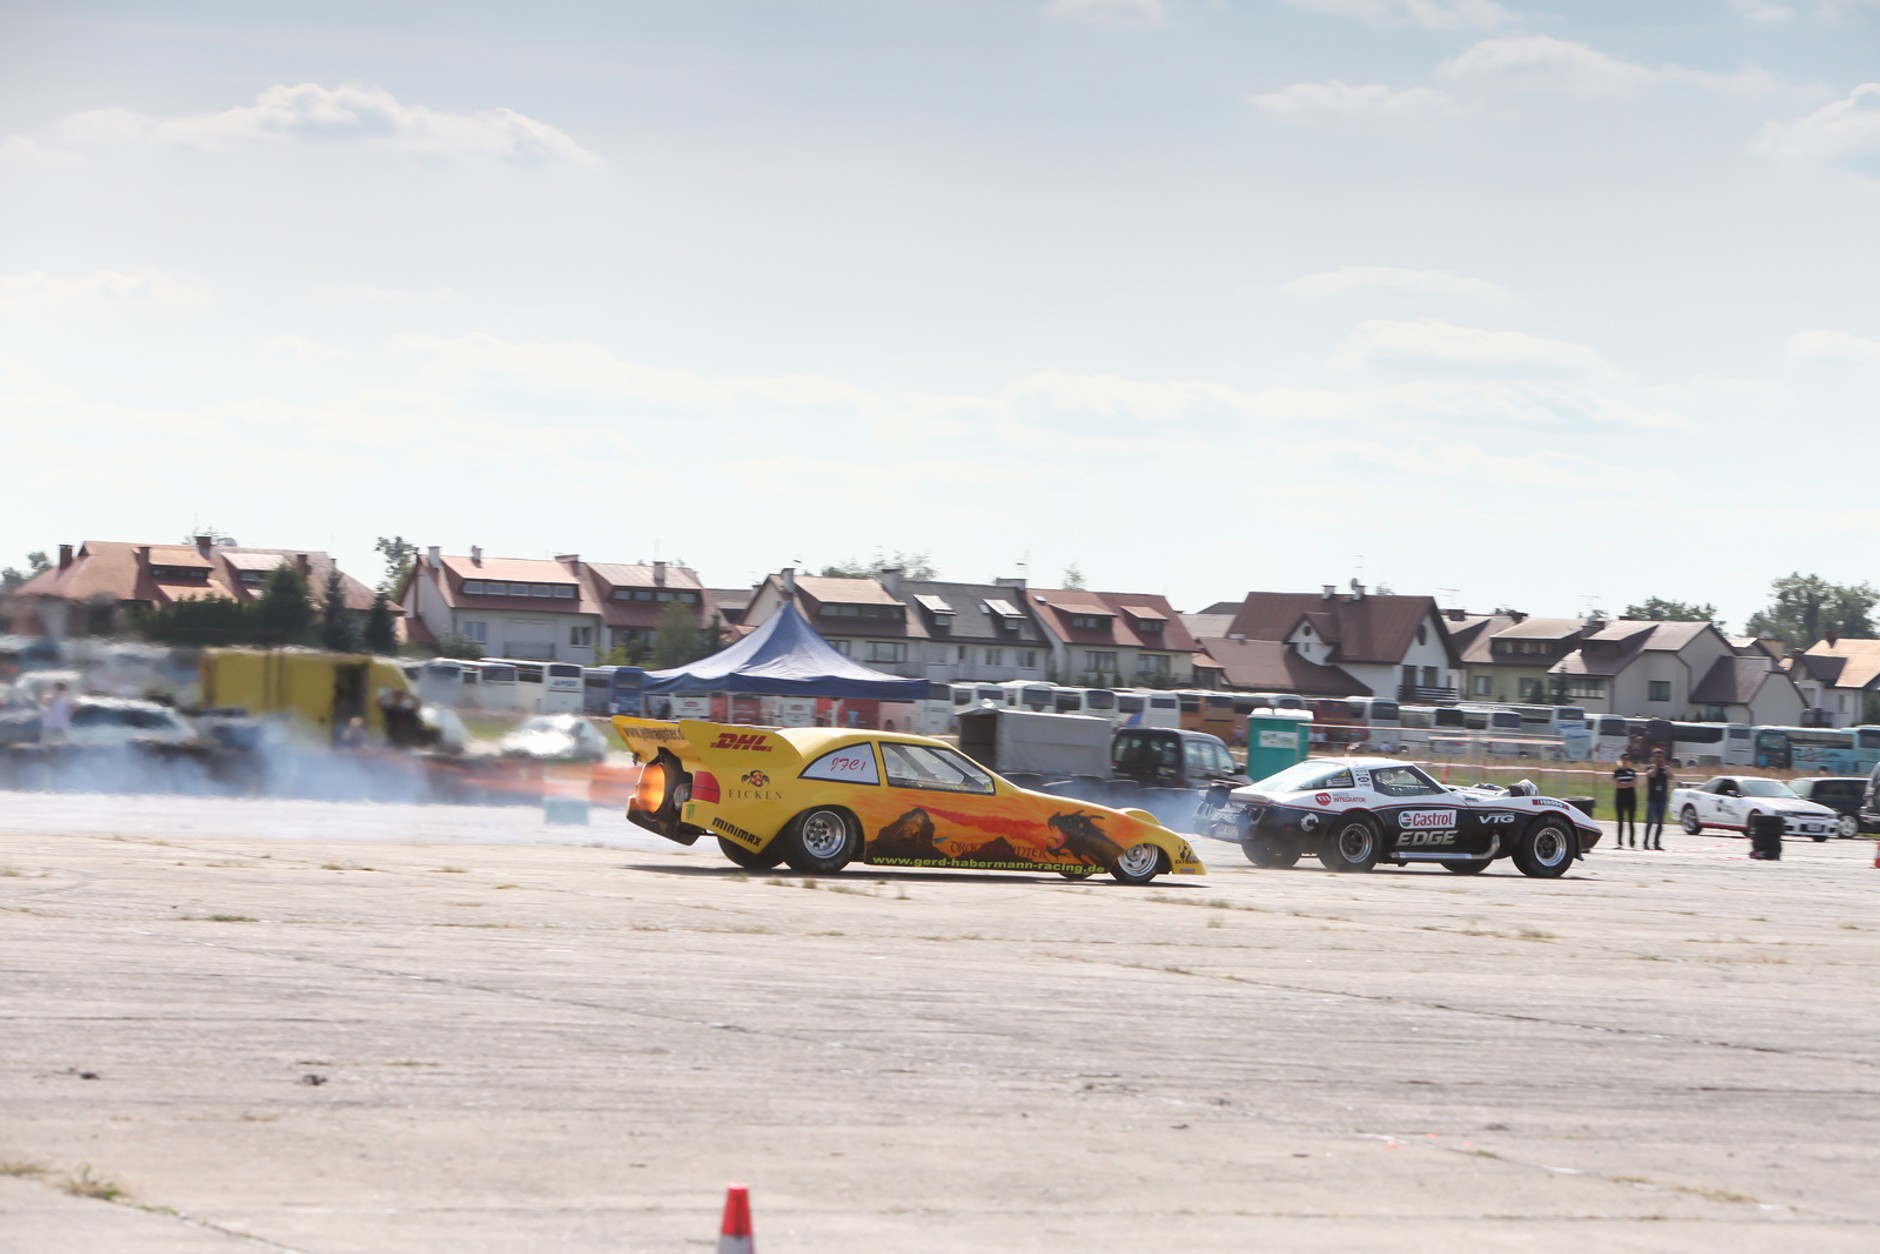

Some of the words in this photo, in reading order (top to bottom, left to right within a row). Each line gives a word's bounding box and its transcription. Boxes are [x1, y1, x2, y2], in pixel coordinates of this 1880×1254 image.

[710, 732, 773, 752] DHL
[728, 789, 783, 800] FICKEN
[1413, 812, 1453, 827] Castrol
[1479, 814, 1515, 824] VTG
[1396, 830, 1459, 847] EDGE
[872, 856, 1105, 874] www.gerd-habermann-racing.de
